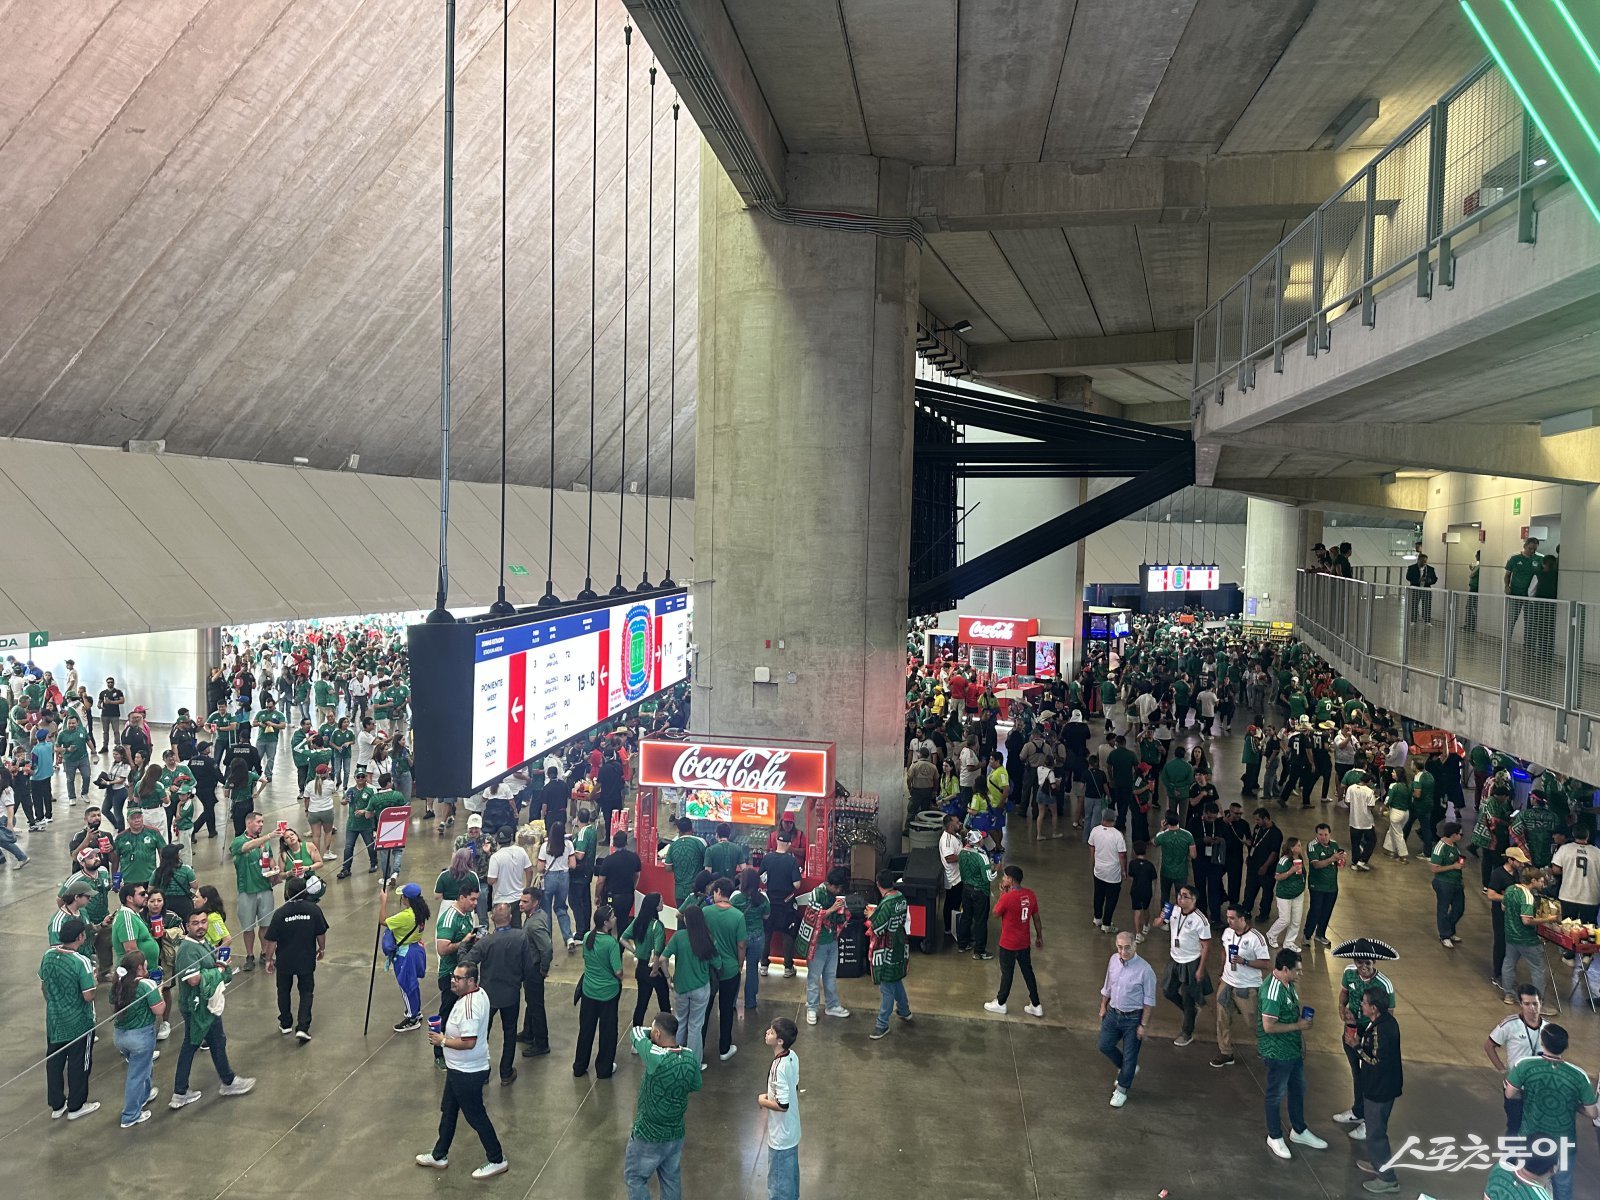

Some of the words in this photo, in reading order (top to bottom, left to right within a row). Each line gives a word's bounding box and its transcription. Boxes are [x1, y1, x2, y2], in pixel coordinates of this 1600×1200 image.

[969, 620, 1014, 640] Coca-Cola
[481, 678, 503, 692] PONIENTE
[577, 674, 585, 692] 15
[590, 671, 595, 686] 8
[487, 693, 497, 701] WEST
[486, 736, 495, 746] SUR
[1293, 741, 1300, 756] 9
[672, 745, 790, 792] Coca-Cola
[1575, 856, 1588, 877] 9
[284, 914, 311, 923] cashless
